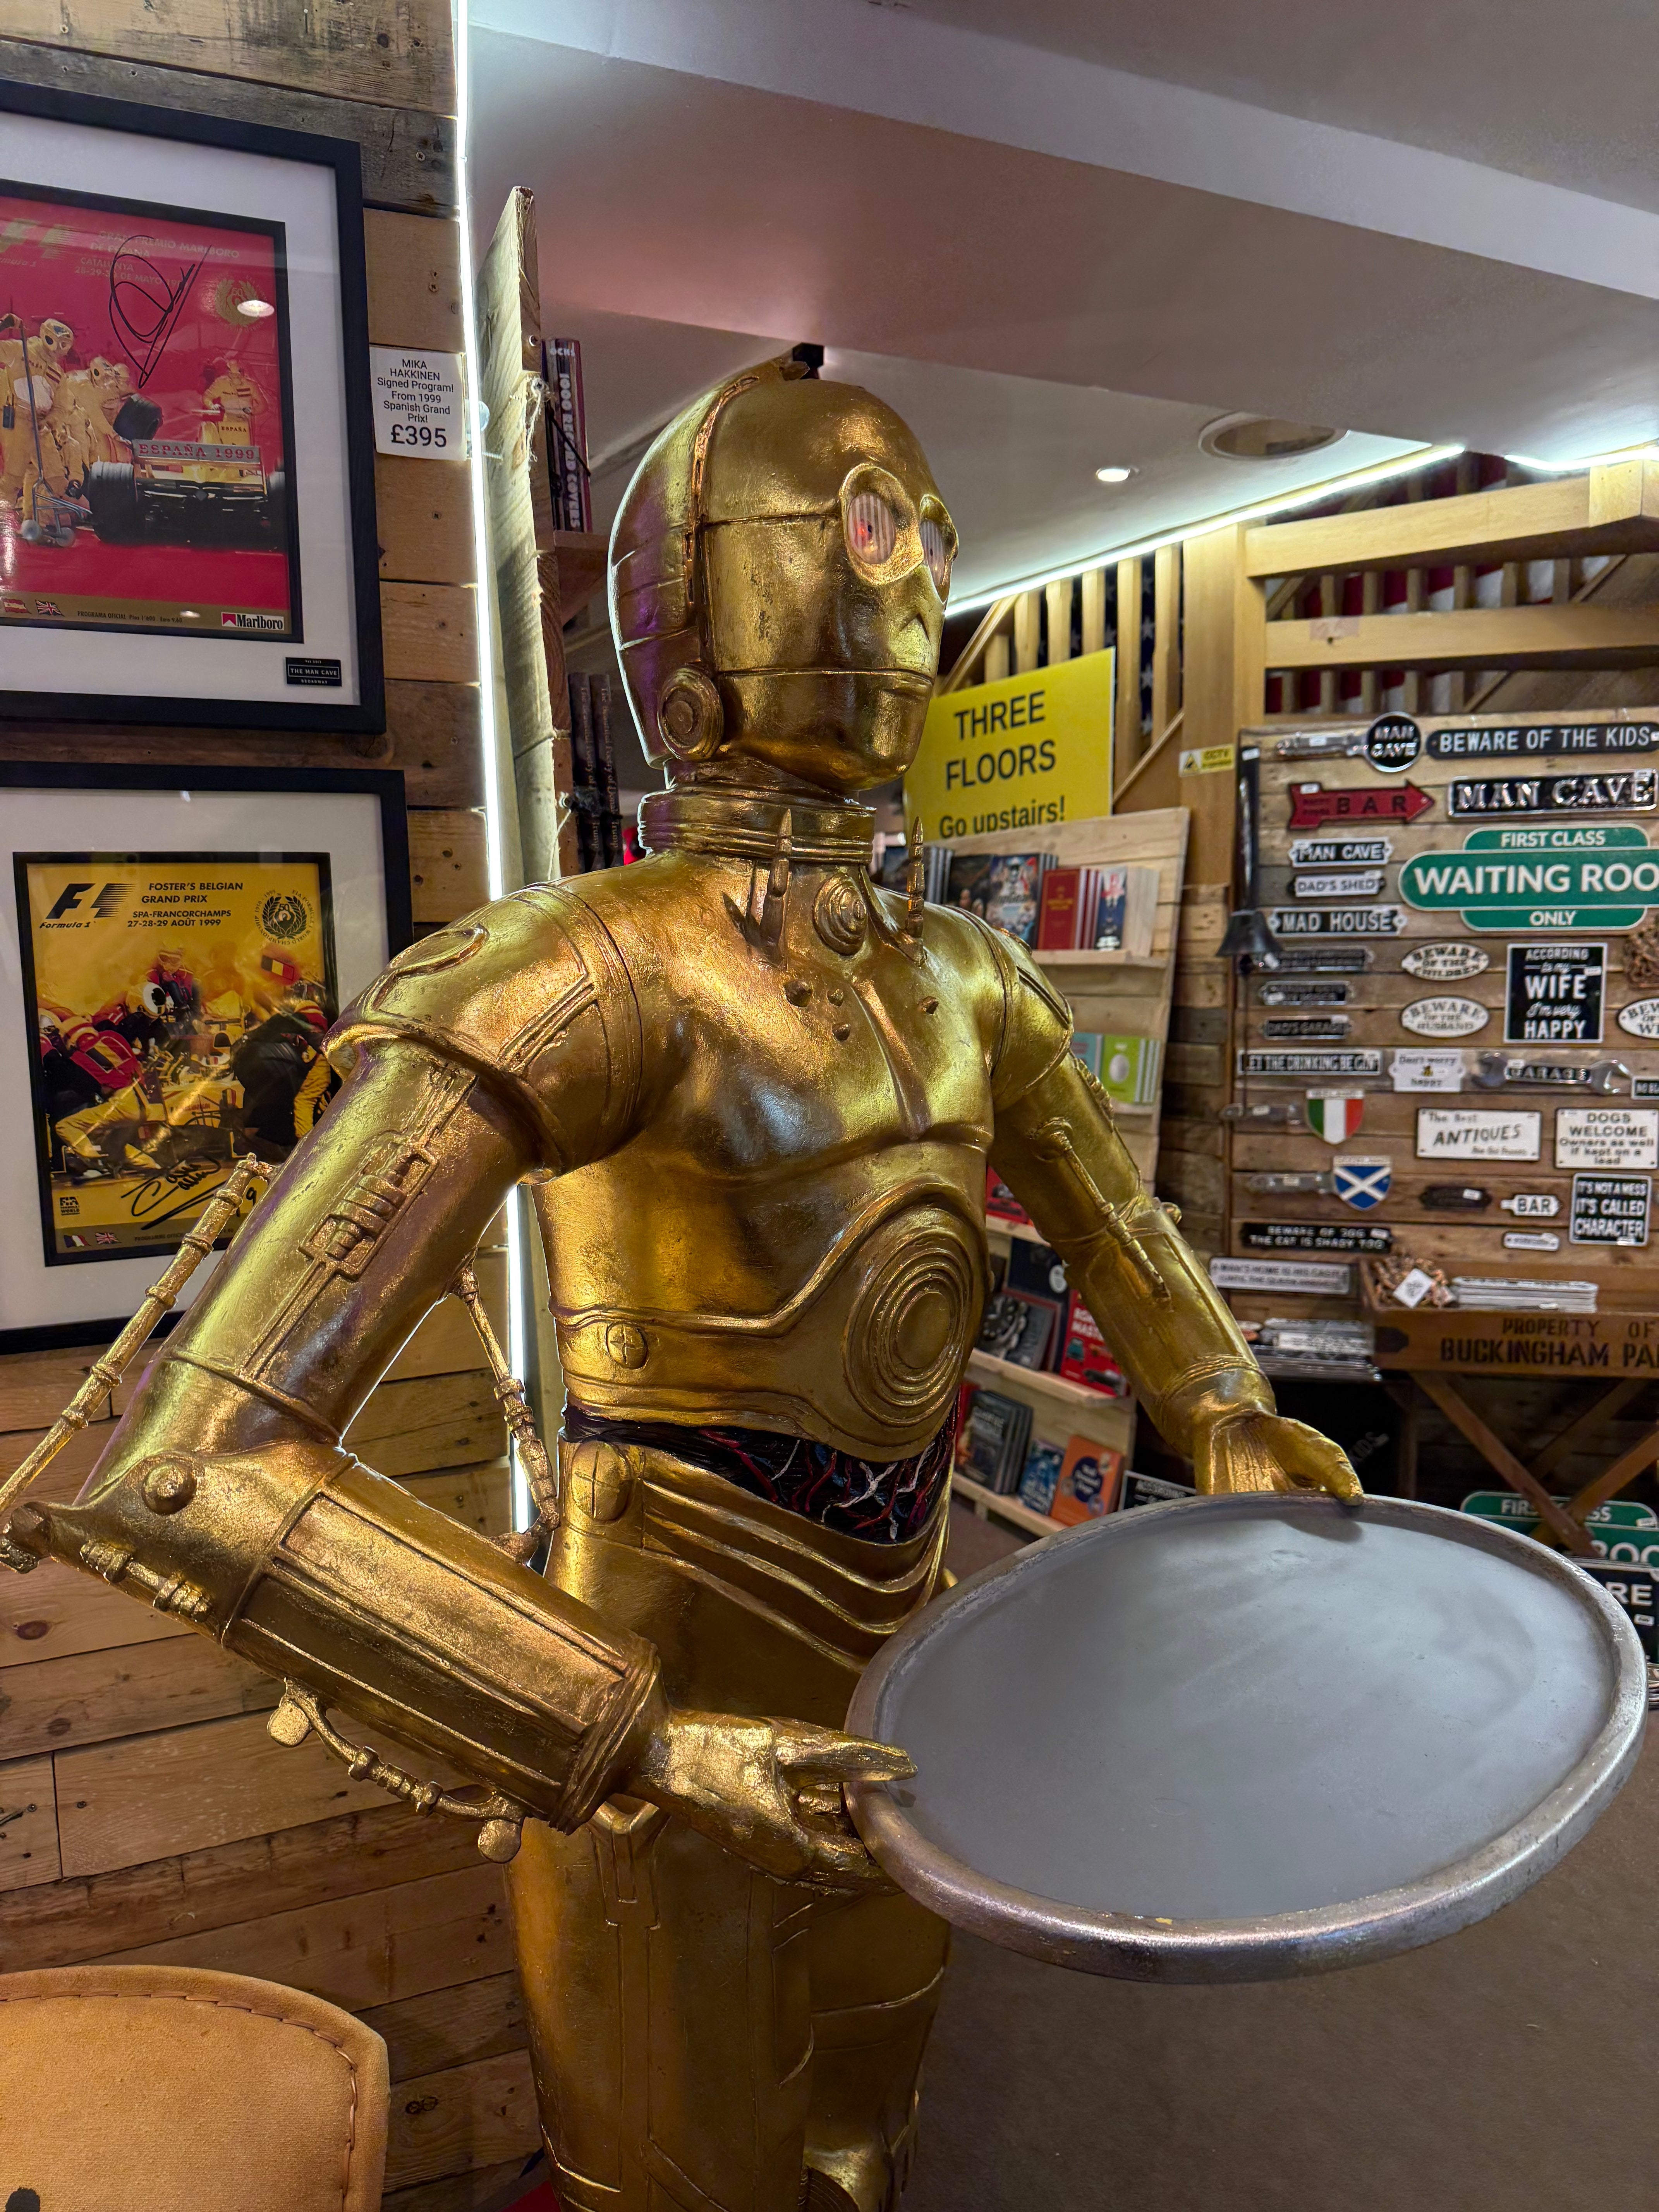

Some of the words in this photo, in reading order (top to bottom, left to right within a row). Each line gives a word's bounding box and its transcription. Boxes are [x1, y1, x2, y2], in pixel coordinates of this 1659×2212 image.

[179, 242, 240, 258] MARLBORO
[80, 257, 134, 272] CATALUNYA
[402, 359, 427, 369] MIKA
[390, 368, 440, 381] HAKKINEN
[377, 378, 409, 388] Signed
[412, 380, 454, 393] Program!
[559, 373, 572, 411] 1000
[392, 391, 416, 401] From
[419, 394, 441, 403] 1999
[383, 400, 420, 412] Spanish
[423, 405, 450, 414] Grand
[408, 413, 428, 423] Prix!
[390, 424, 447, 448] £395
[562, 413, 576, 471] RECORD
[139, 443, 206, 457] ESPAÑA
[215, 448, 254, 459] 1999
[567, 473, 581, 528] COVERS
[236, 614, 283, 630] Marlboro
[955, 690, 1045, 740] THREE
[1375, 725, 1415, 740] MAN
[1439, 730, 1519, 753] BEWARE
[1526, 729, 1553, 749] OF
[1561, 728, 1598, 748] THE
[1606, 726, 1650, 747] KIDS
[1371, 742, 1417, 758] CAVE
[946, 740, 1056, 791] FLOORS
[608, 775, 617, 785] of
[1456, 781, 1540, 810] MAN
[1552, 777, 1650, 807] CAVE
[1337, 795, 1407, 814] BAR
[940, 816, 966, 838] Go
[973, 796, 1065, 835] upstairs!
[1501, 831, 1548, 848] FIRST
[1551, 830, 1606, 847] CLASS
[1298, 845, 1333, 861] MAN
[1342, 843, 1383, 860] CAVE
[149, 883, 196, 891] FOSTER'S
[199, 882, 243, 890] BELGIAN
[1297, 880, 1336, 891] DAD'S
[1341, 878, 1376, 890] SHED
[1413, 864, 1571, 895] WAITING
[45, 883, 137, 919] F1
[184, 895, 208, 903] PRIX
[127, 919, 168, 927] 27-28-29
[171, 917, 196, 927] AOÛT
[132, 910, 232, 918] SPA-FRANCORCHAMPS
[1283, 912, 1322, 931] MAD
[1329, 911, 1393, 930] HOUSE
[1529, 910, 1577, 926] ONLY
[1412, 946, 1484, 961] BEWARE
[1525, 948, 1590, 961] ACCORDING
[1414, 964, 1479, 976] CHILDREN
[1525, 974, 1587, 1000] WIFE
[1410, 1001, 1482, 1019] BEWARE
[1524, 1019, 1587, 1039] HAPPY
[1587, 1112, 1631, 1123] DOGS
[1433, 1123, 1522, 1146] ANTIQUES
[1570, 1125, 1648, 1137] WELCOME
[1559, 1137, 1606, 1146] Owners
[1629, 1138, 1654, 1146] well
[1577, 1180, 1594, 1194] IT'S
[1594, 1181, 1614, 1195] NOT
[1613, 1182, 1621, 1195] A
[1621, 1182, 1647, 1197] MESS
[1517, 1197, 1550, 1212] BAR
[1575, 1197, 1599, 1215] IT'S
[1600, 1198, 1645, 1216] CALLED
[1267, 1225, 1316, 1237] BEWARE
[1319, 1227, 1336, 1237] OF
[1575, 1217, 1644, 1238] CHARACTER
[1249, 1234, 1274, 1246] THE
[1502, 1318, 1600, 1337] PROPERTY
[1628, 1321, 1656, 1338] OF
[1441, 1338, 1609, 1367] BUCKINGHAM
